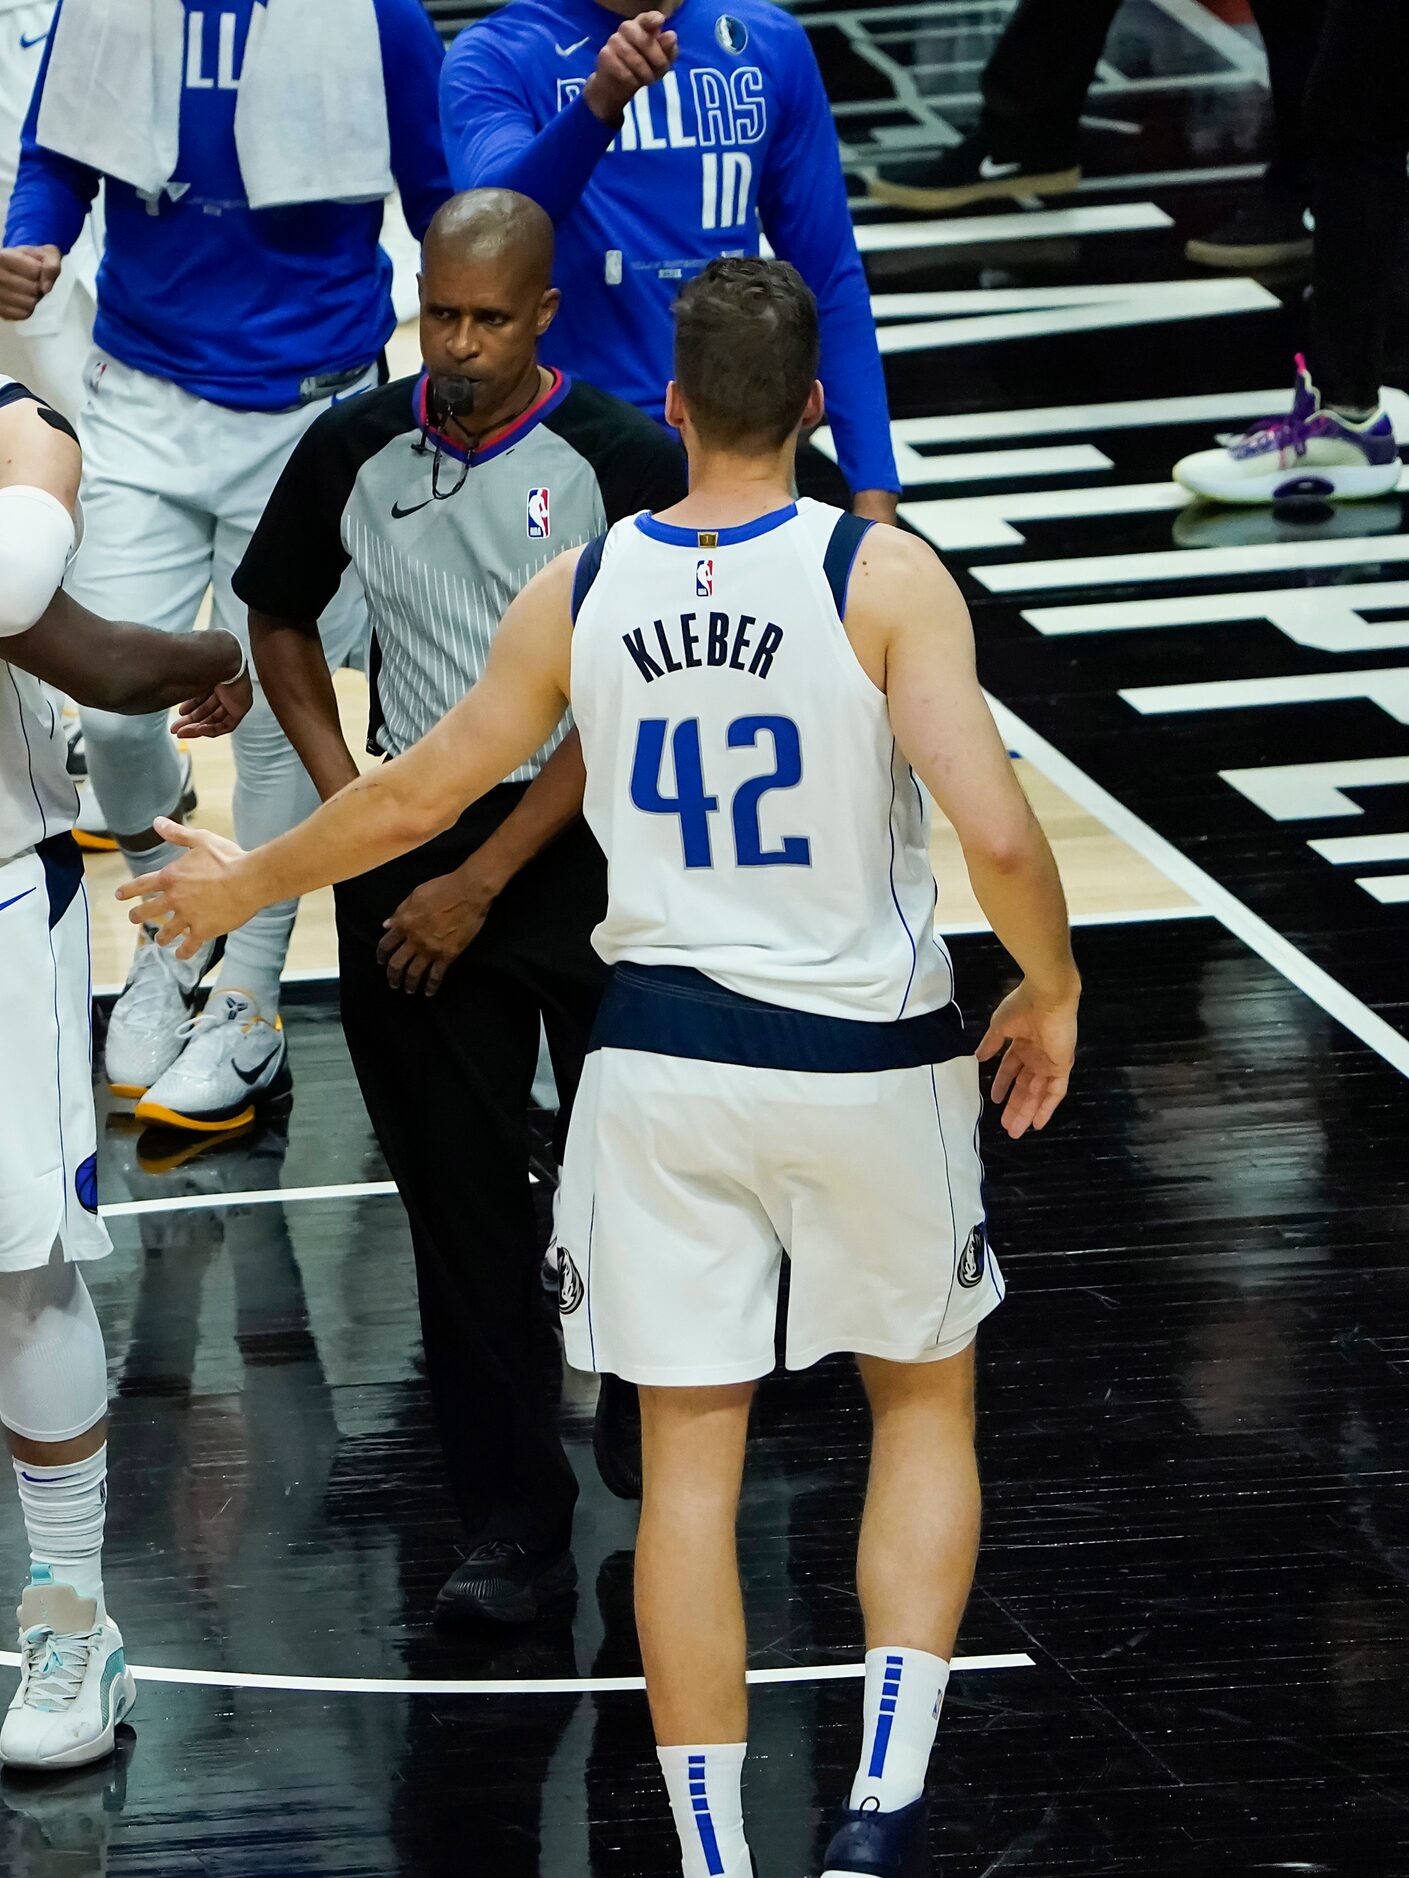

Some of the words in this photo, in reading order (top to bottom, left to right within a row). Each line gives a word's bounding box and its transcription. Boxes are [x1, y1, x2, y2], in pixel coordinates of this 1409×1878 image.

[702, 152, 752, 230] IN
[622, 611, 784, 683] KLEBER
[629, 713, 812, 870] 42
